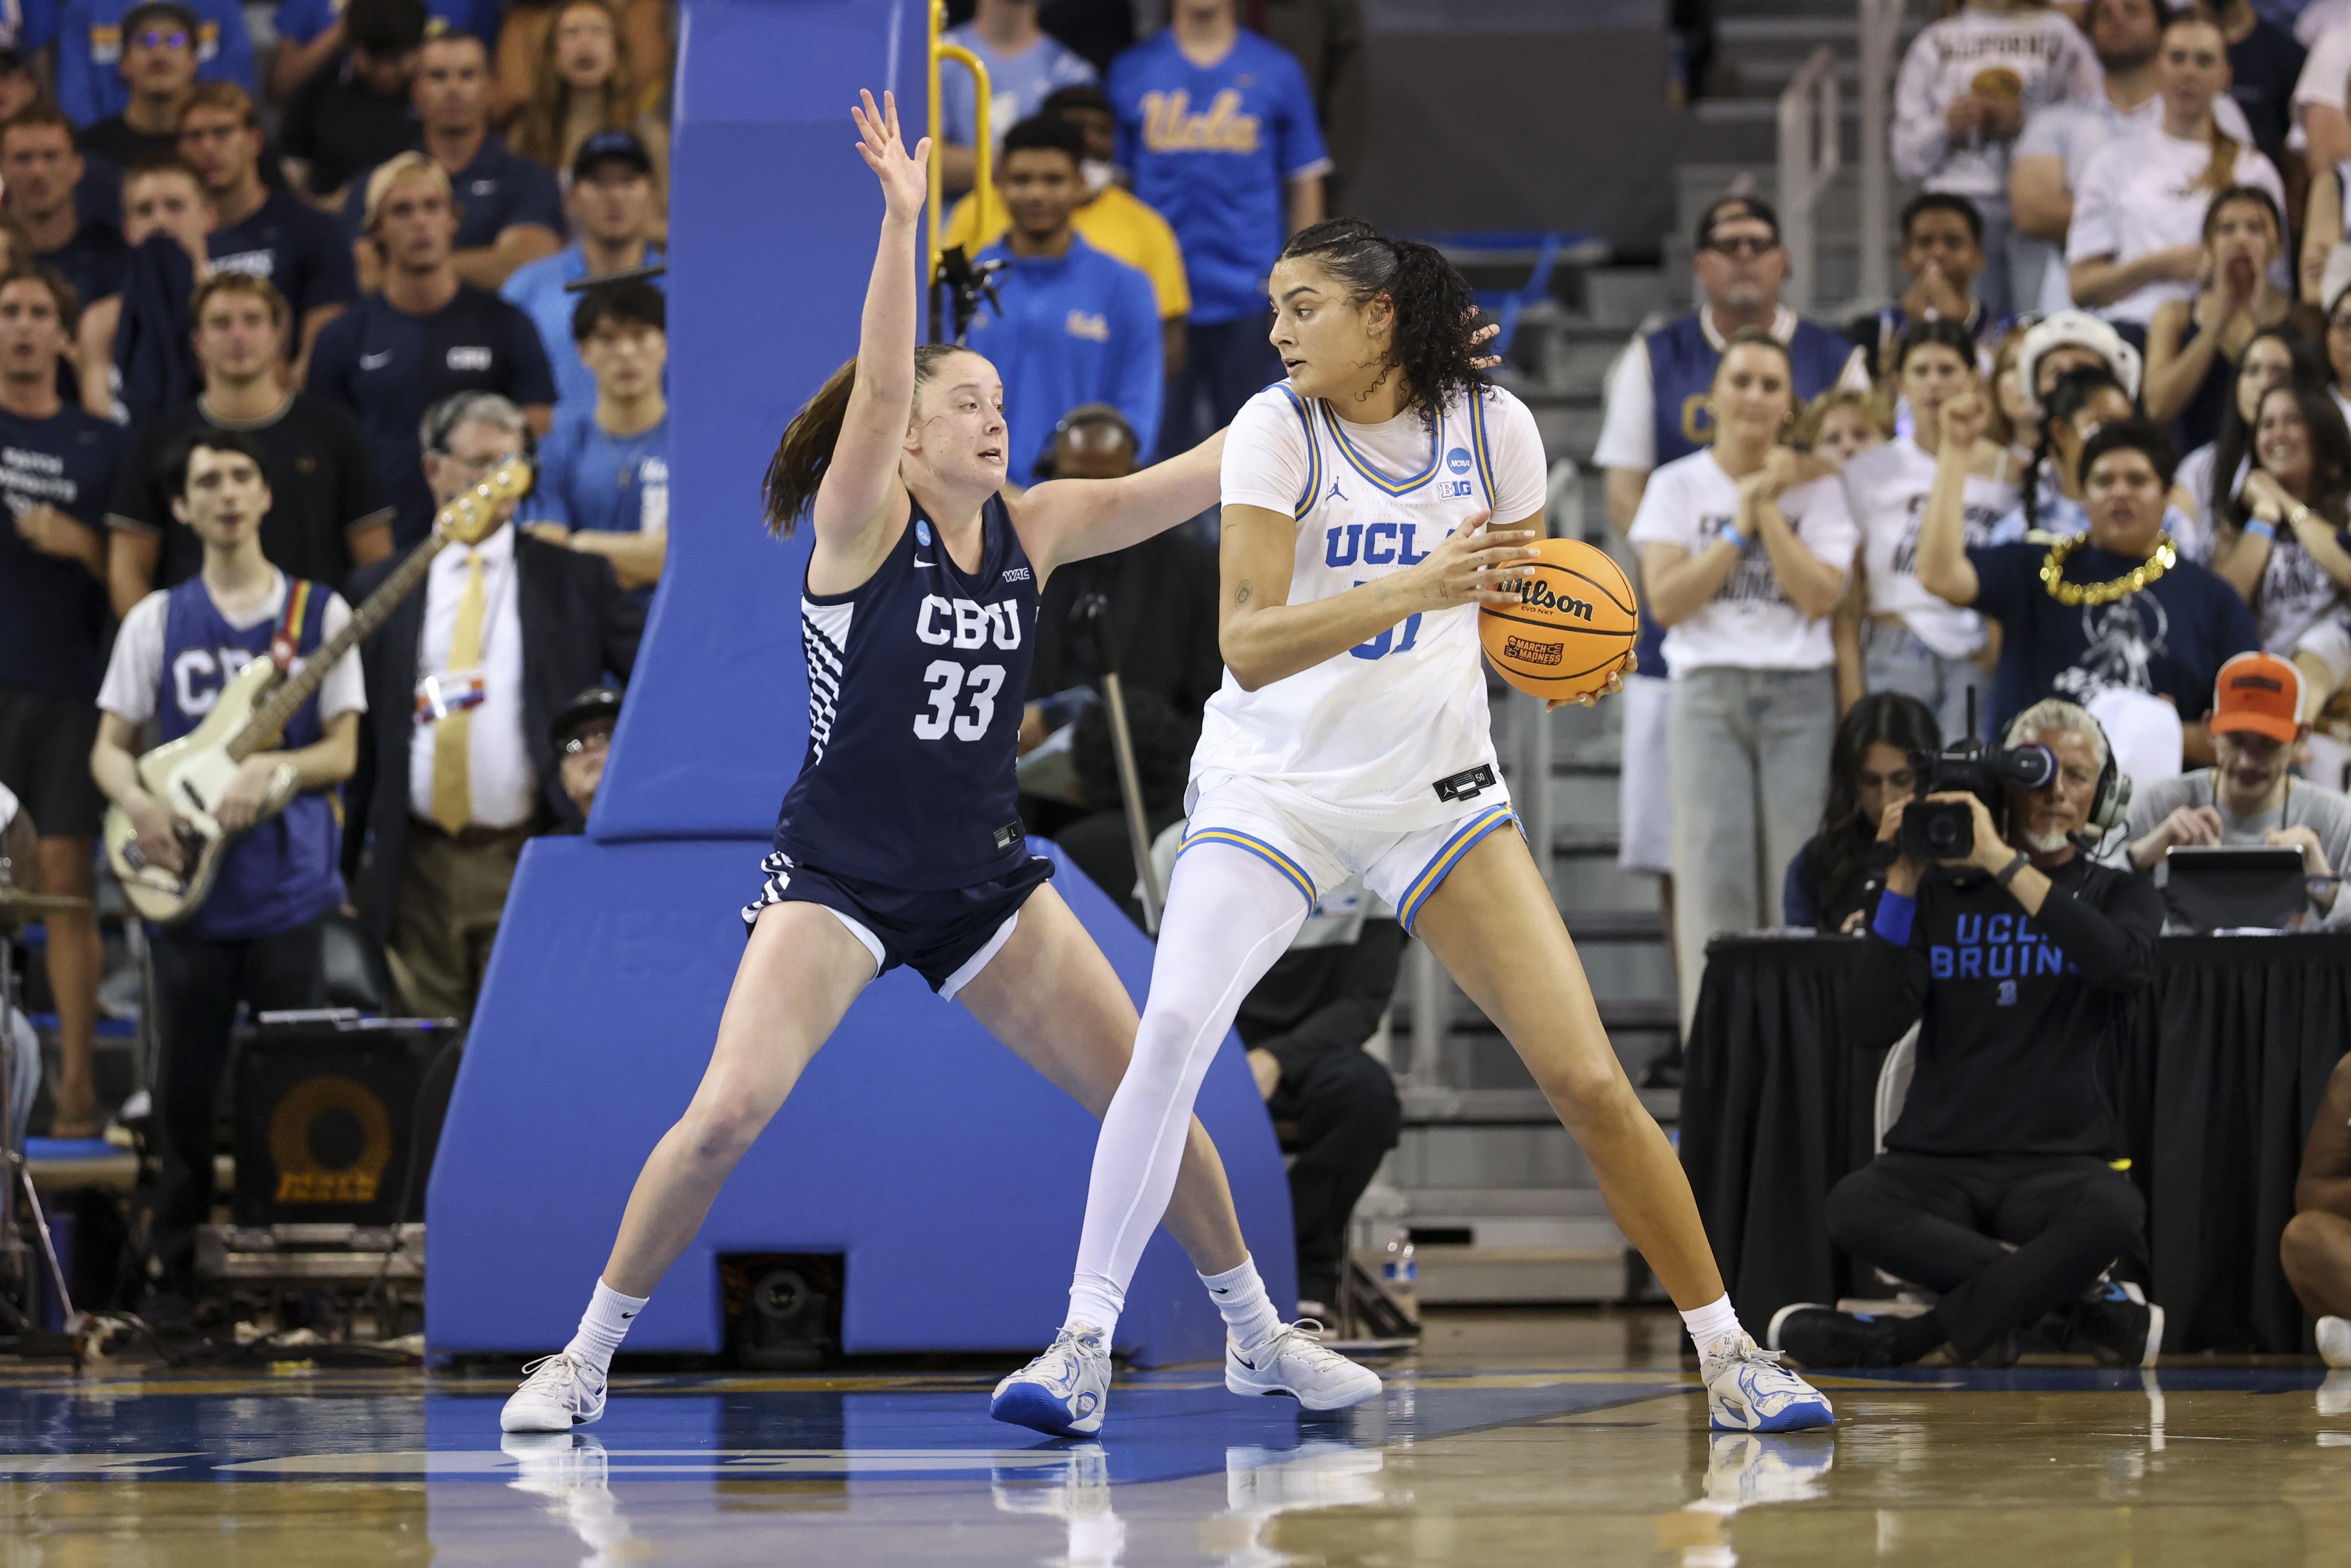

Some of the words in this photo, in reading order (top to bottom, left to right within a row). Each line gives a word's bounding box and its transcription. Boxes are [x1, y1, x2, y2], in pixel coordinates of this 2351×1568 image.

[1325, 523, 1455, 568] UCL
[1002, 567, 1030, 583] WAC
[916, 593, 1022, 650] CBU
[1516, 639, 1547, 653] MARCH
[1519, 649, 1561, 663] MADNESS
[913, 659, 1007, 741] 33
[1475, 772, 1485, 782] 50
[1956, 913, 2049, 945] UCL
[1930, 944, 2082, 979] BRUIN
